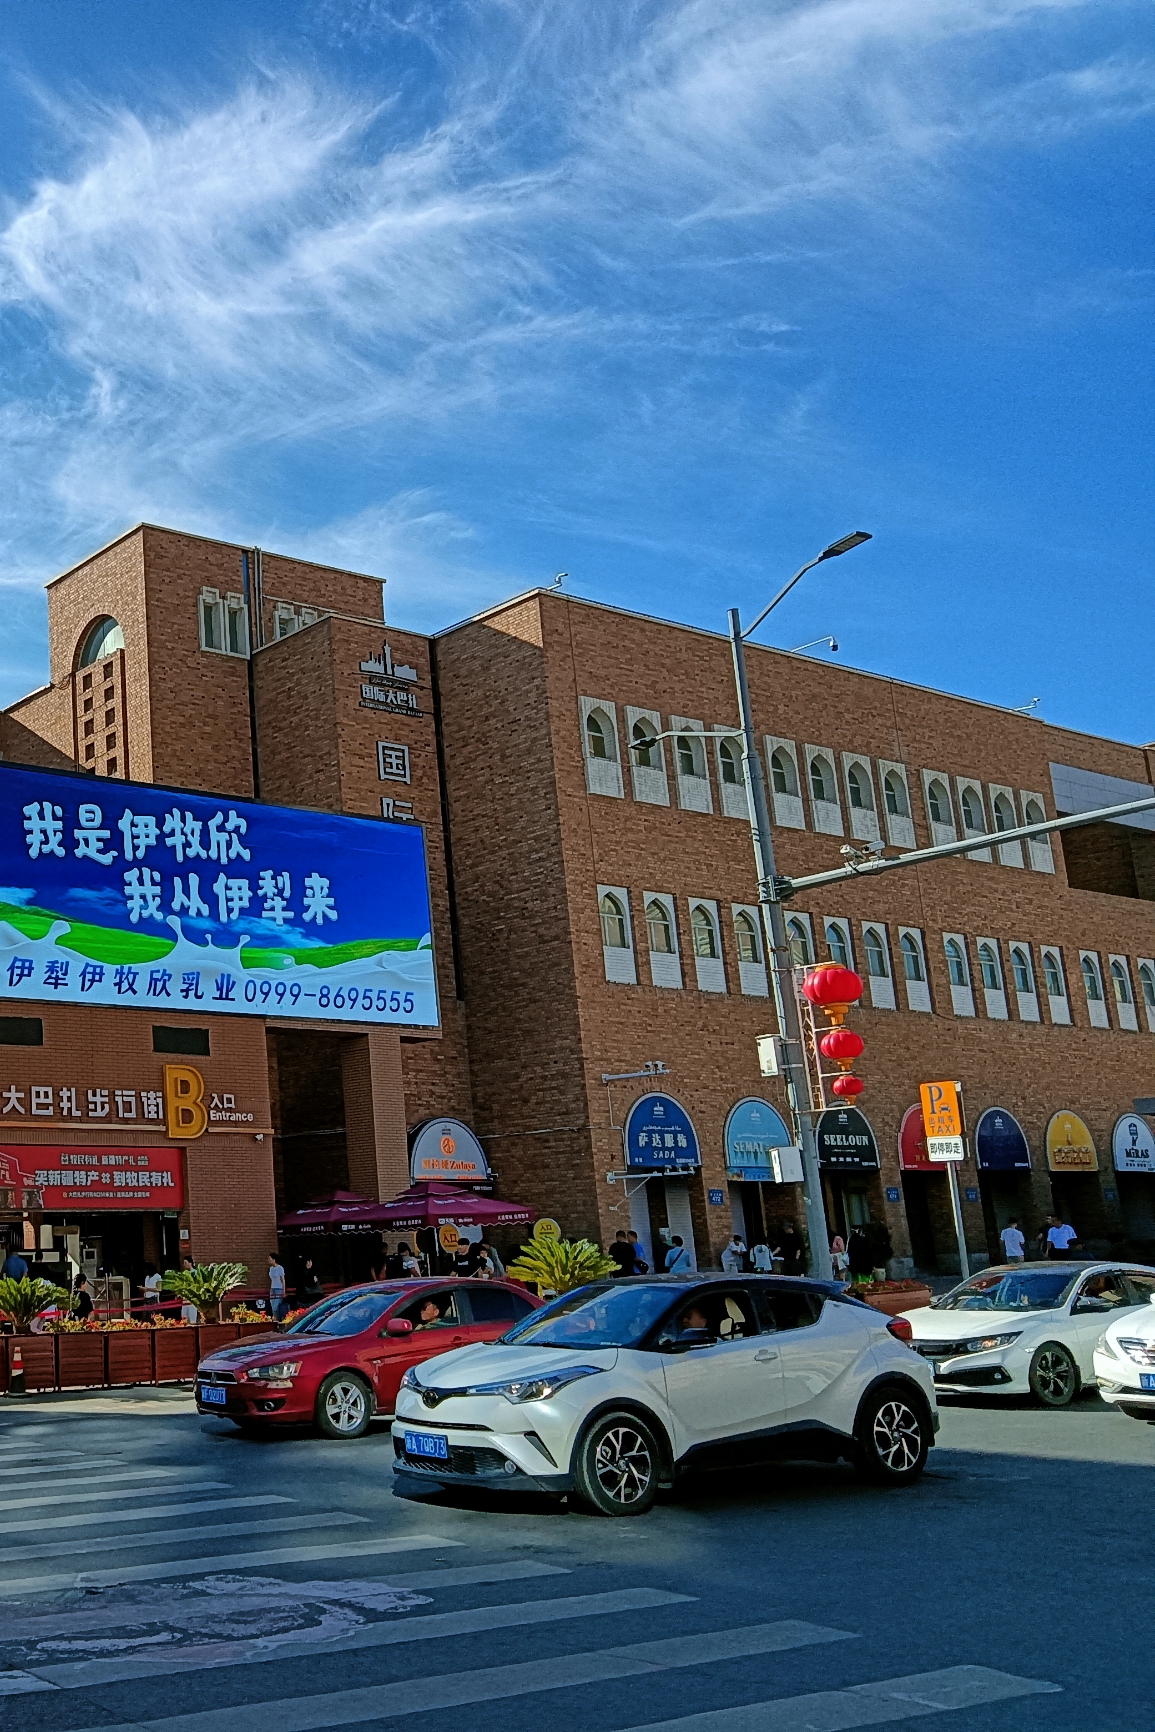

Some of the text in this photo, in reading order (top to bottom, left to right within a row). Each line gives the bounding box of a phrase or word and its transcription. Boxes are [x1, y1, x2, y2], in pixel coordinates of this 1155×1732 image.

[361, 684, 419, 709] 国际大巴扎
[22, 801, 251, 866] 我是伊牧欣
[123, 866, 339, 926] 我从伊犁来
[7, 956, 415, 1014] 伊犁伊牧欣乳业 0999-8695555
[1, 1064, 236, 1139] 大巴扎步行街 B 入口
[927, 1085, 943, 1114] P
[209, 1109, 254, 1123] Entrance
[928, 1116, 955, 1125] 出租车
[930, 1125, 956, 1134] TAXI
[823, 1134, 869, 1146] SEELOUN
[653, 1150, 675, 1159] SADA
[929, 1142, 961, 1155] 即停即走
[35, 1170, 175, 1187] 买新疆特产 到牧民有礼
[540, 1223, 553, 1232] 入口
[443, 1233, 458, 1244] 入口
